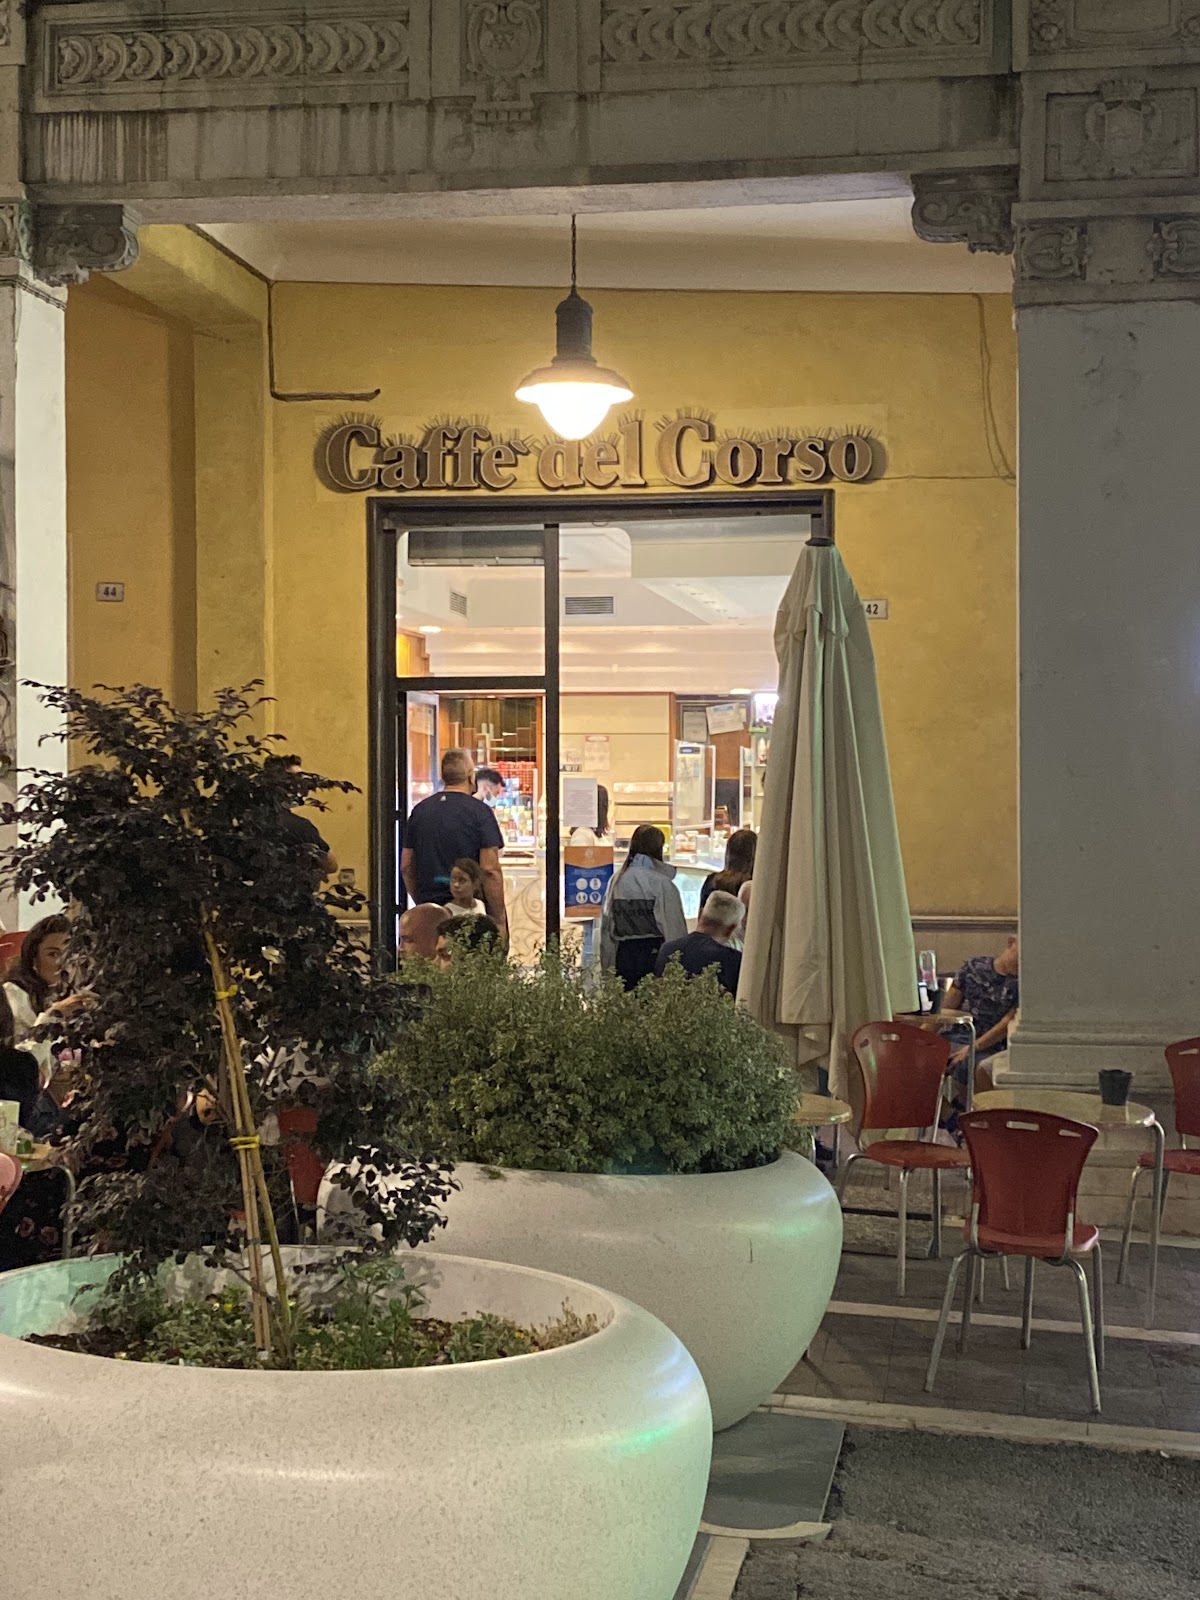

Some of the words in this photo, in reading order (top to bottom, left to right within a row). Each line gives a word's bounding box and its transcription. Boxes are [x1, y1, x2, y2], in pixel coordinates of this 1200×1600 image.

[538, 420, 647, 488] del
[655, 417, 873, 487] Corso
[103, 586, 117, 596] 44
[865, 603, 879, 615] 42
